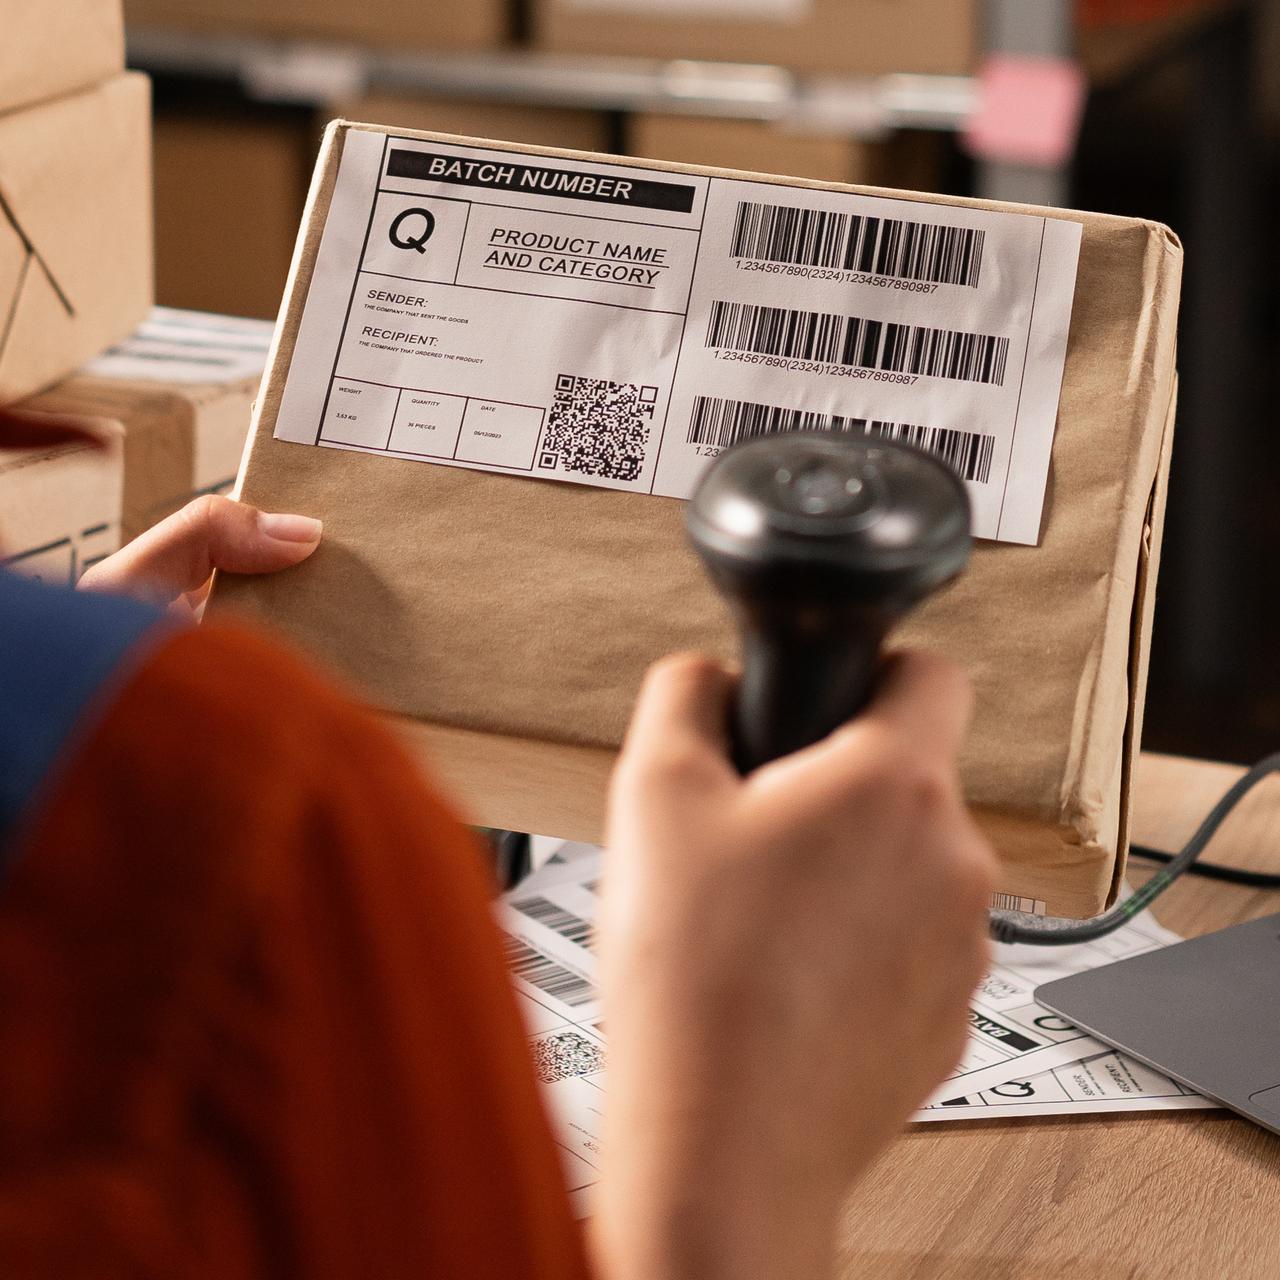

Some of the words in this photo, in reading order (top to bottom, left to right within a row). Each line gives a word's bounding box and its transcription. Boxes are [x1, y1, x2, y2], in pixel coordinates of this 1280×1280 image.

[429, 157, 515, 185] BATCH
[520, 169, 633, 200] NUMBER
[388, 207, 435, 254] Q
[490, 228, 598, 255] PRODUCT
[603, 243, 667, 264] NAME
[485, 250, 532, 268] AND
[538, 258, 660, 285] CATEGORY
[734, 260, 939, 295] 1.234567890(2324)1234567890987
[367, 289, 429, 308] SENDER:
[376, 306, 404, 315] COMPANY
[361, 326, 439, 347] RECIPIENT:
[370, 342, 399, 352] COMPANY
[415, 350, 443, 358] ORDERED
[455, 356, 484, 365] PRODUCT
[713, 349, 919, 387] 1.234567890(2324)1234567890987
[338, 386, 362, 396] WEIGHT
[411, 398, 440, 407] QUANTITY
